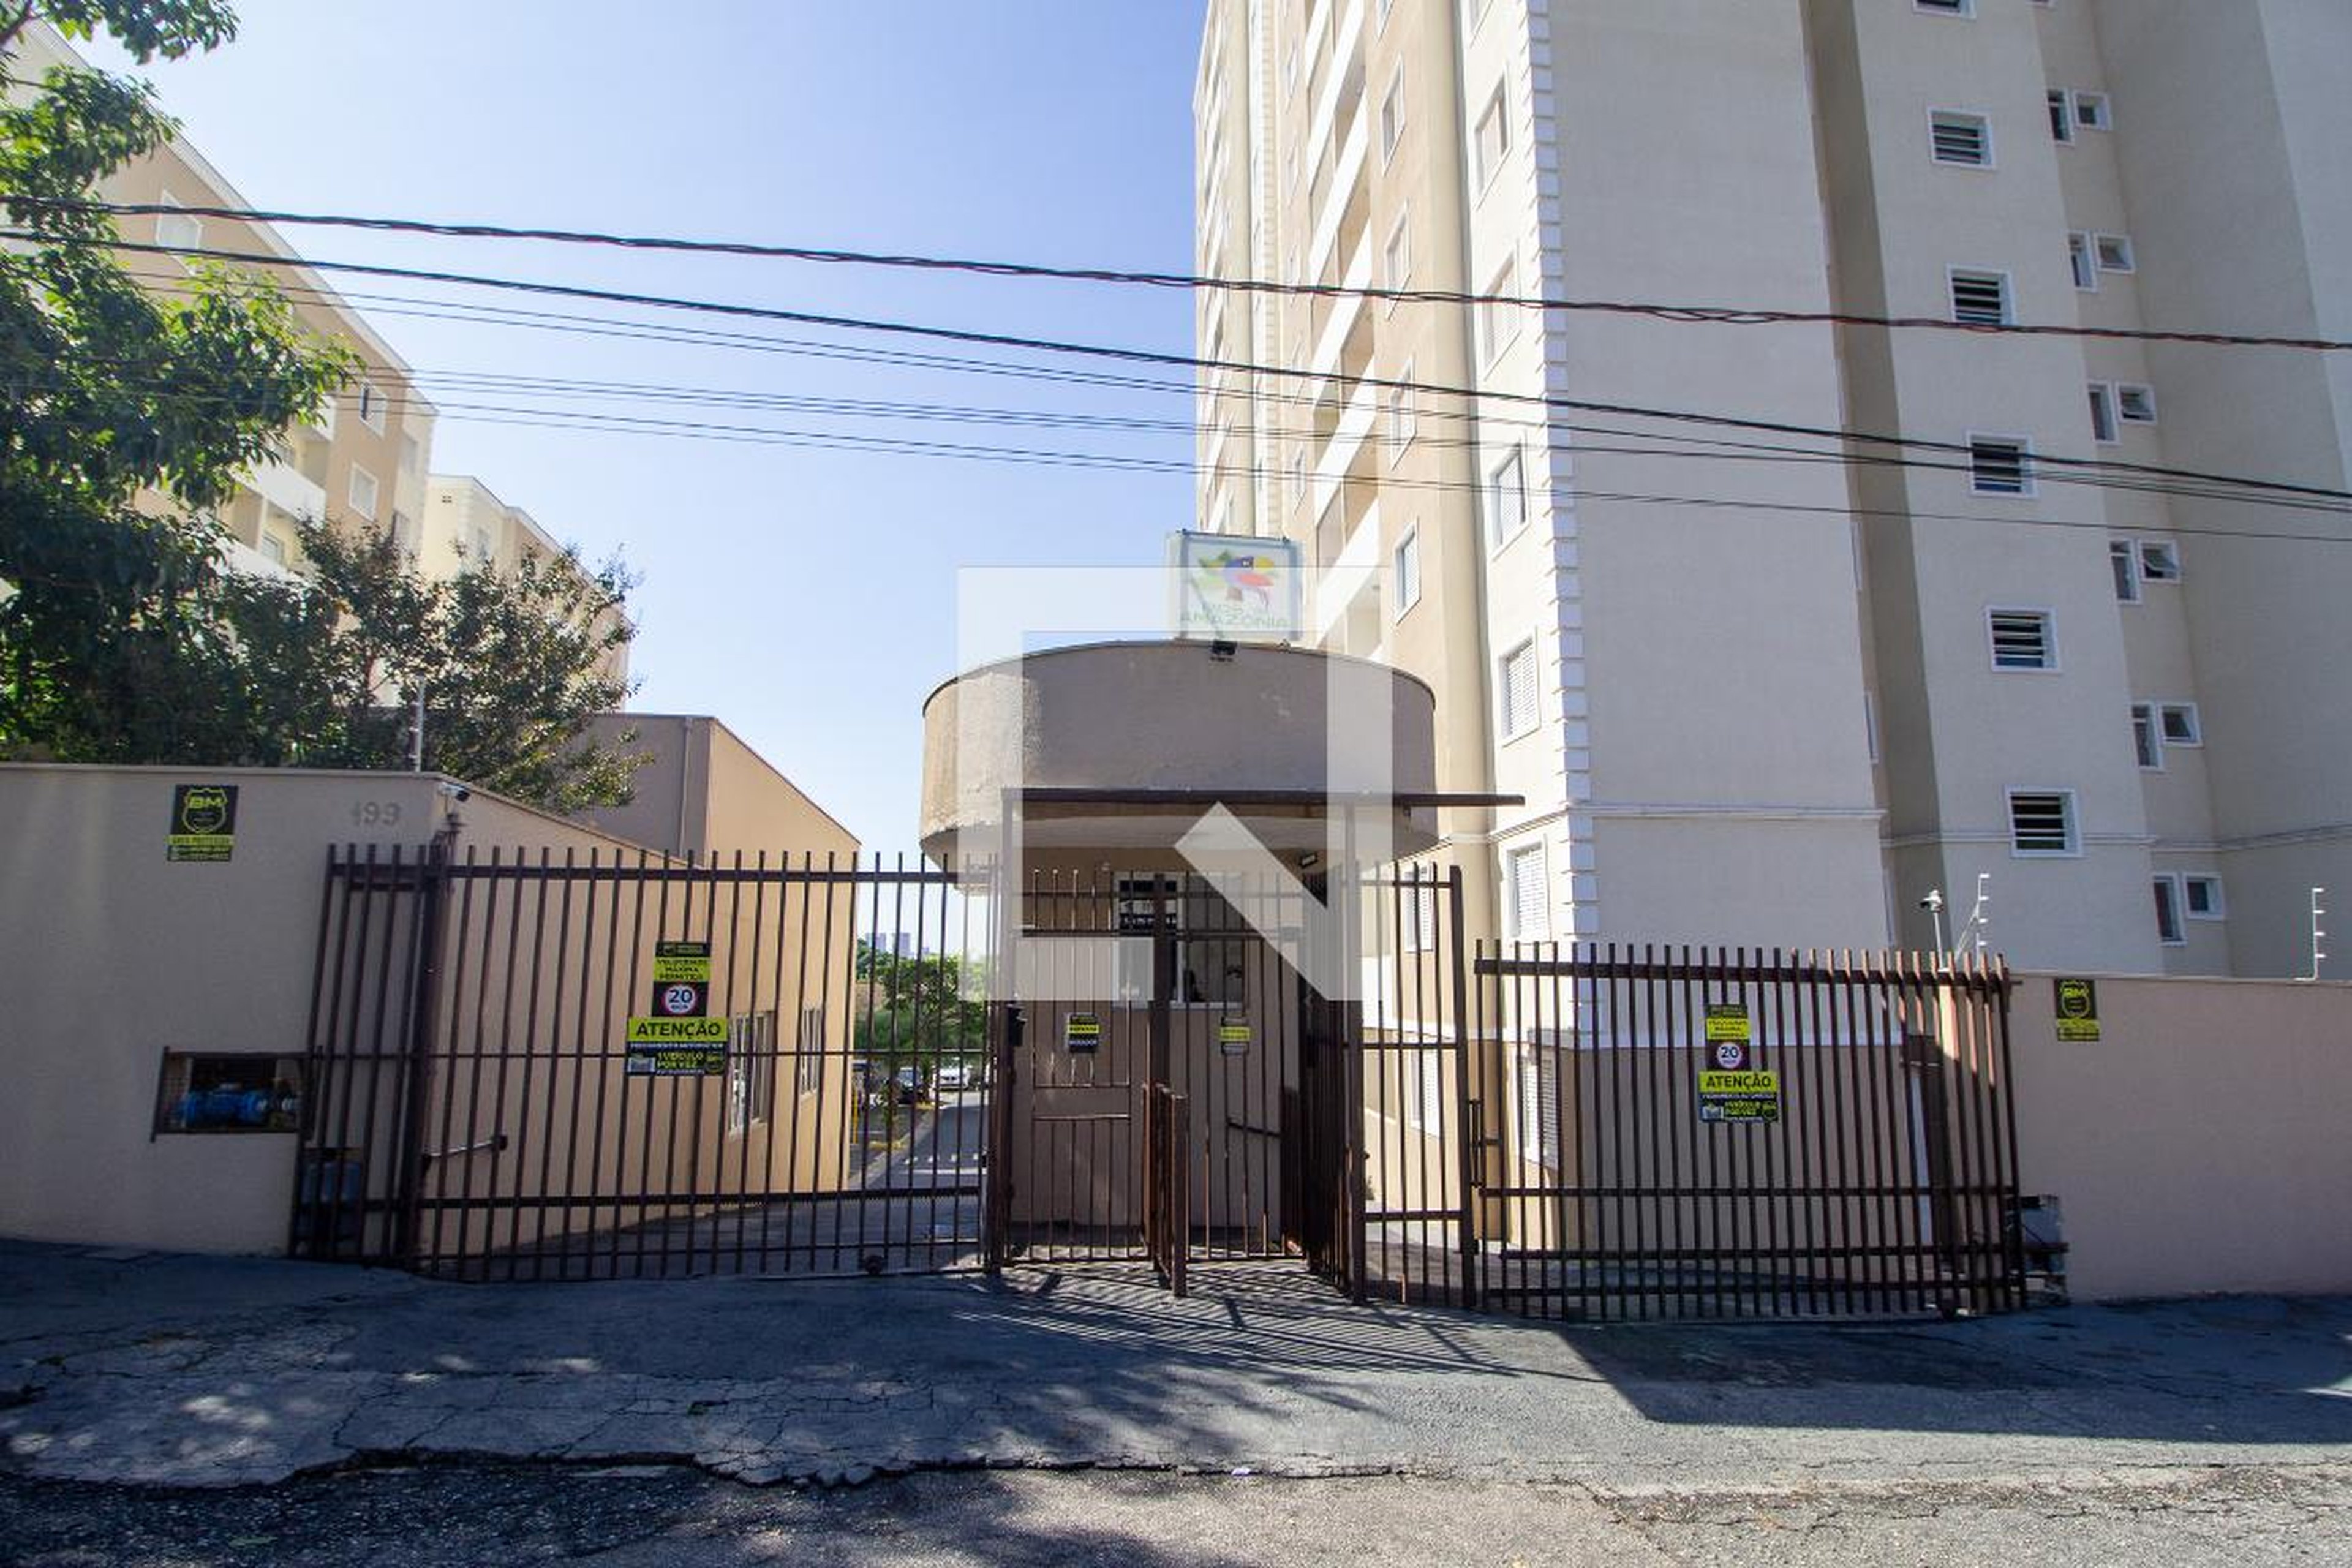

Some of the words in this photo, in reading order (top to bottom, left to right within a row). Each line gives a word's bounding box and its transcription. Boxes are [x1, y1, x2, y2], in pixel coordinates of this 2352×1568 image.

[669, 989, 692, 1003] 20
[636, 1019, 721, 1039] ATENÇÃO
[1721, 1046, 1739, 1058] 20
[1706, 1074, 1771, 1090] ATENÇÃO
